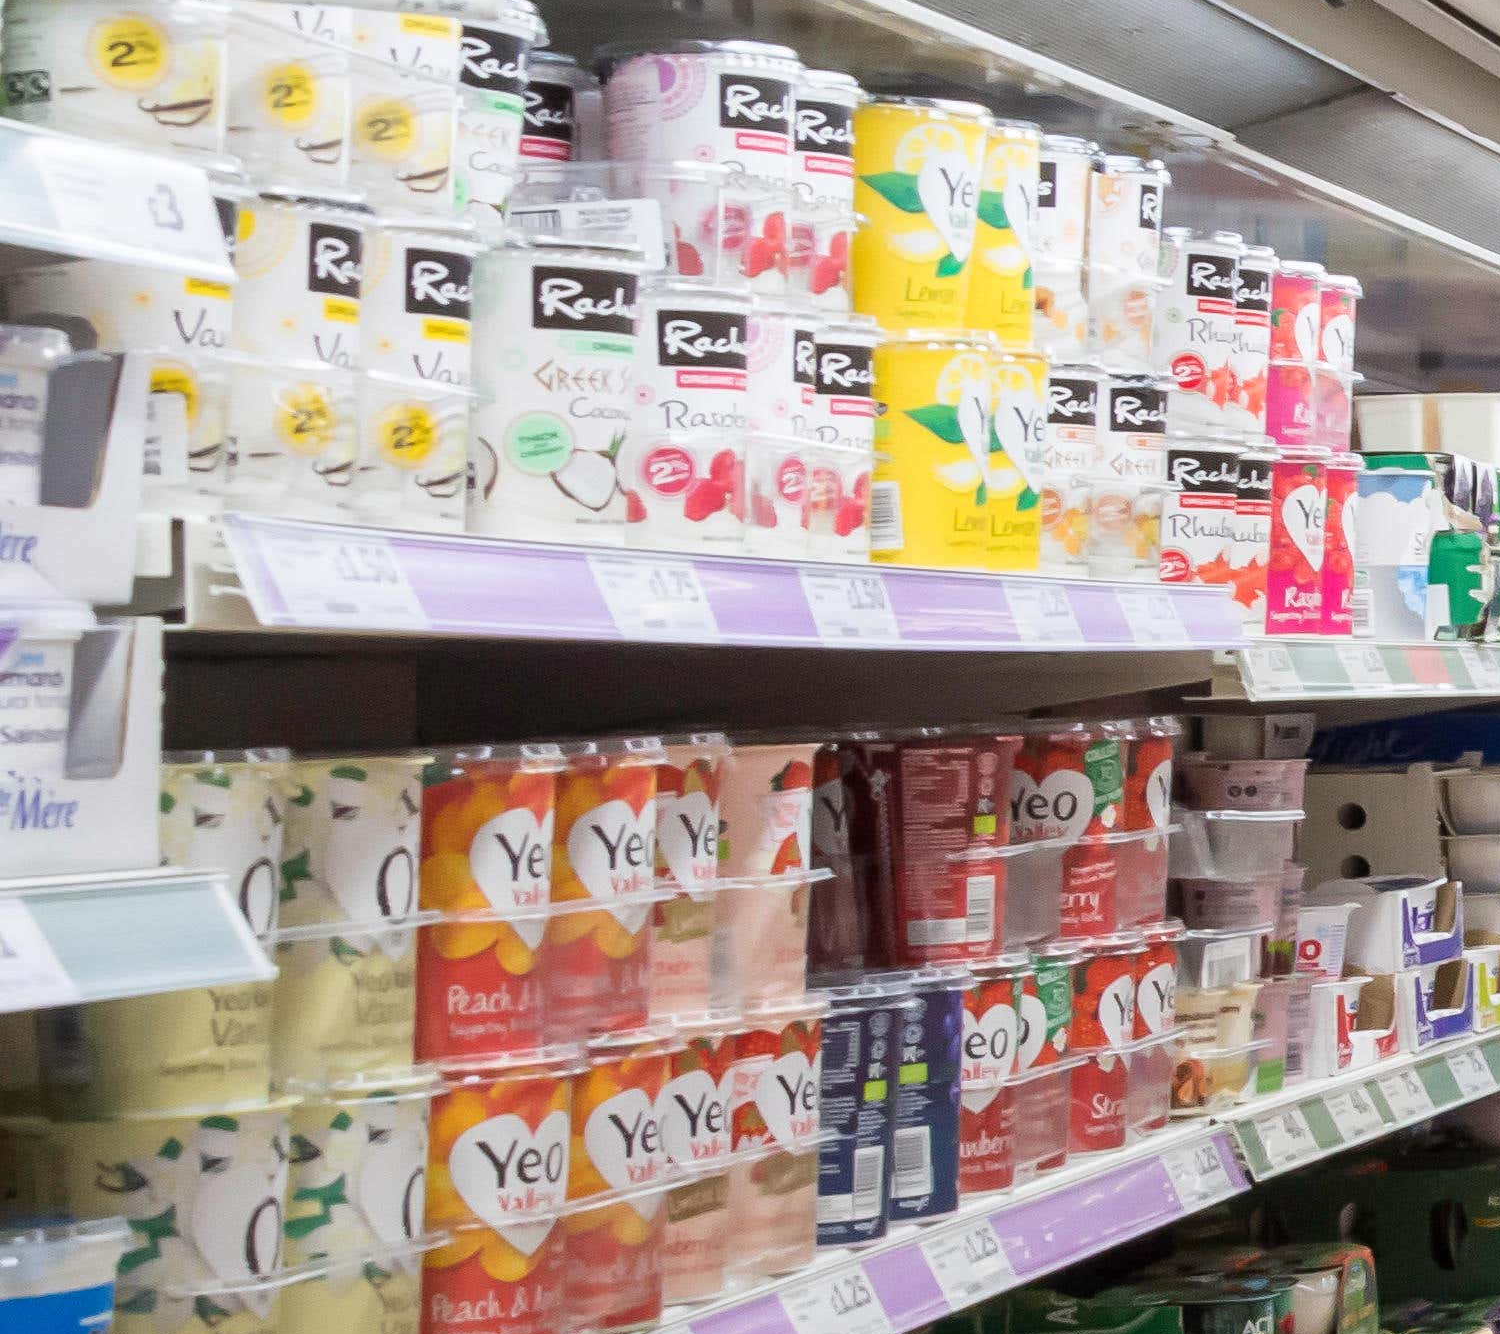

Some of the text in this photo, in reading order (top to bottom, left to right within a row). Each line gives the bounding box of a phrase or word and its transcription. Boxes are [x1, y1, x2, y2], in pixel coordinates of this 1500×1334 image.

[475, 1139, 565, 1190] Yeo
[431, 1293, 503, 1323] Peach
[830, 1273, 874, 1318] £1.25
